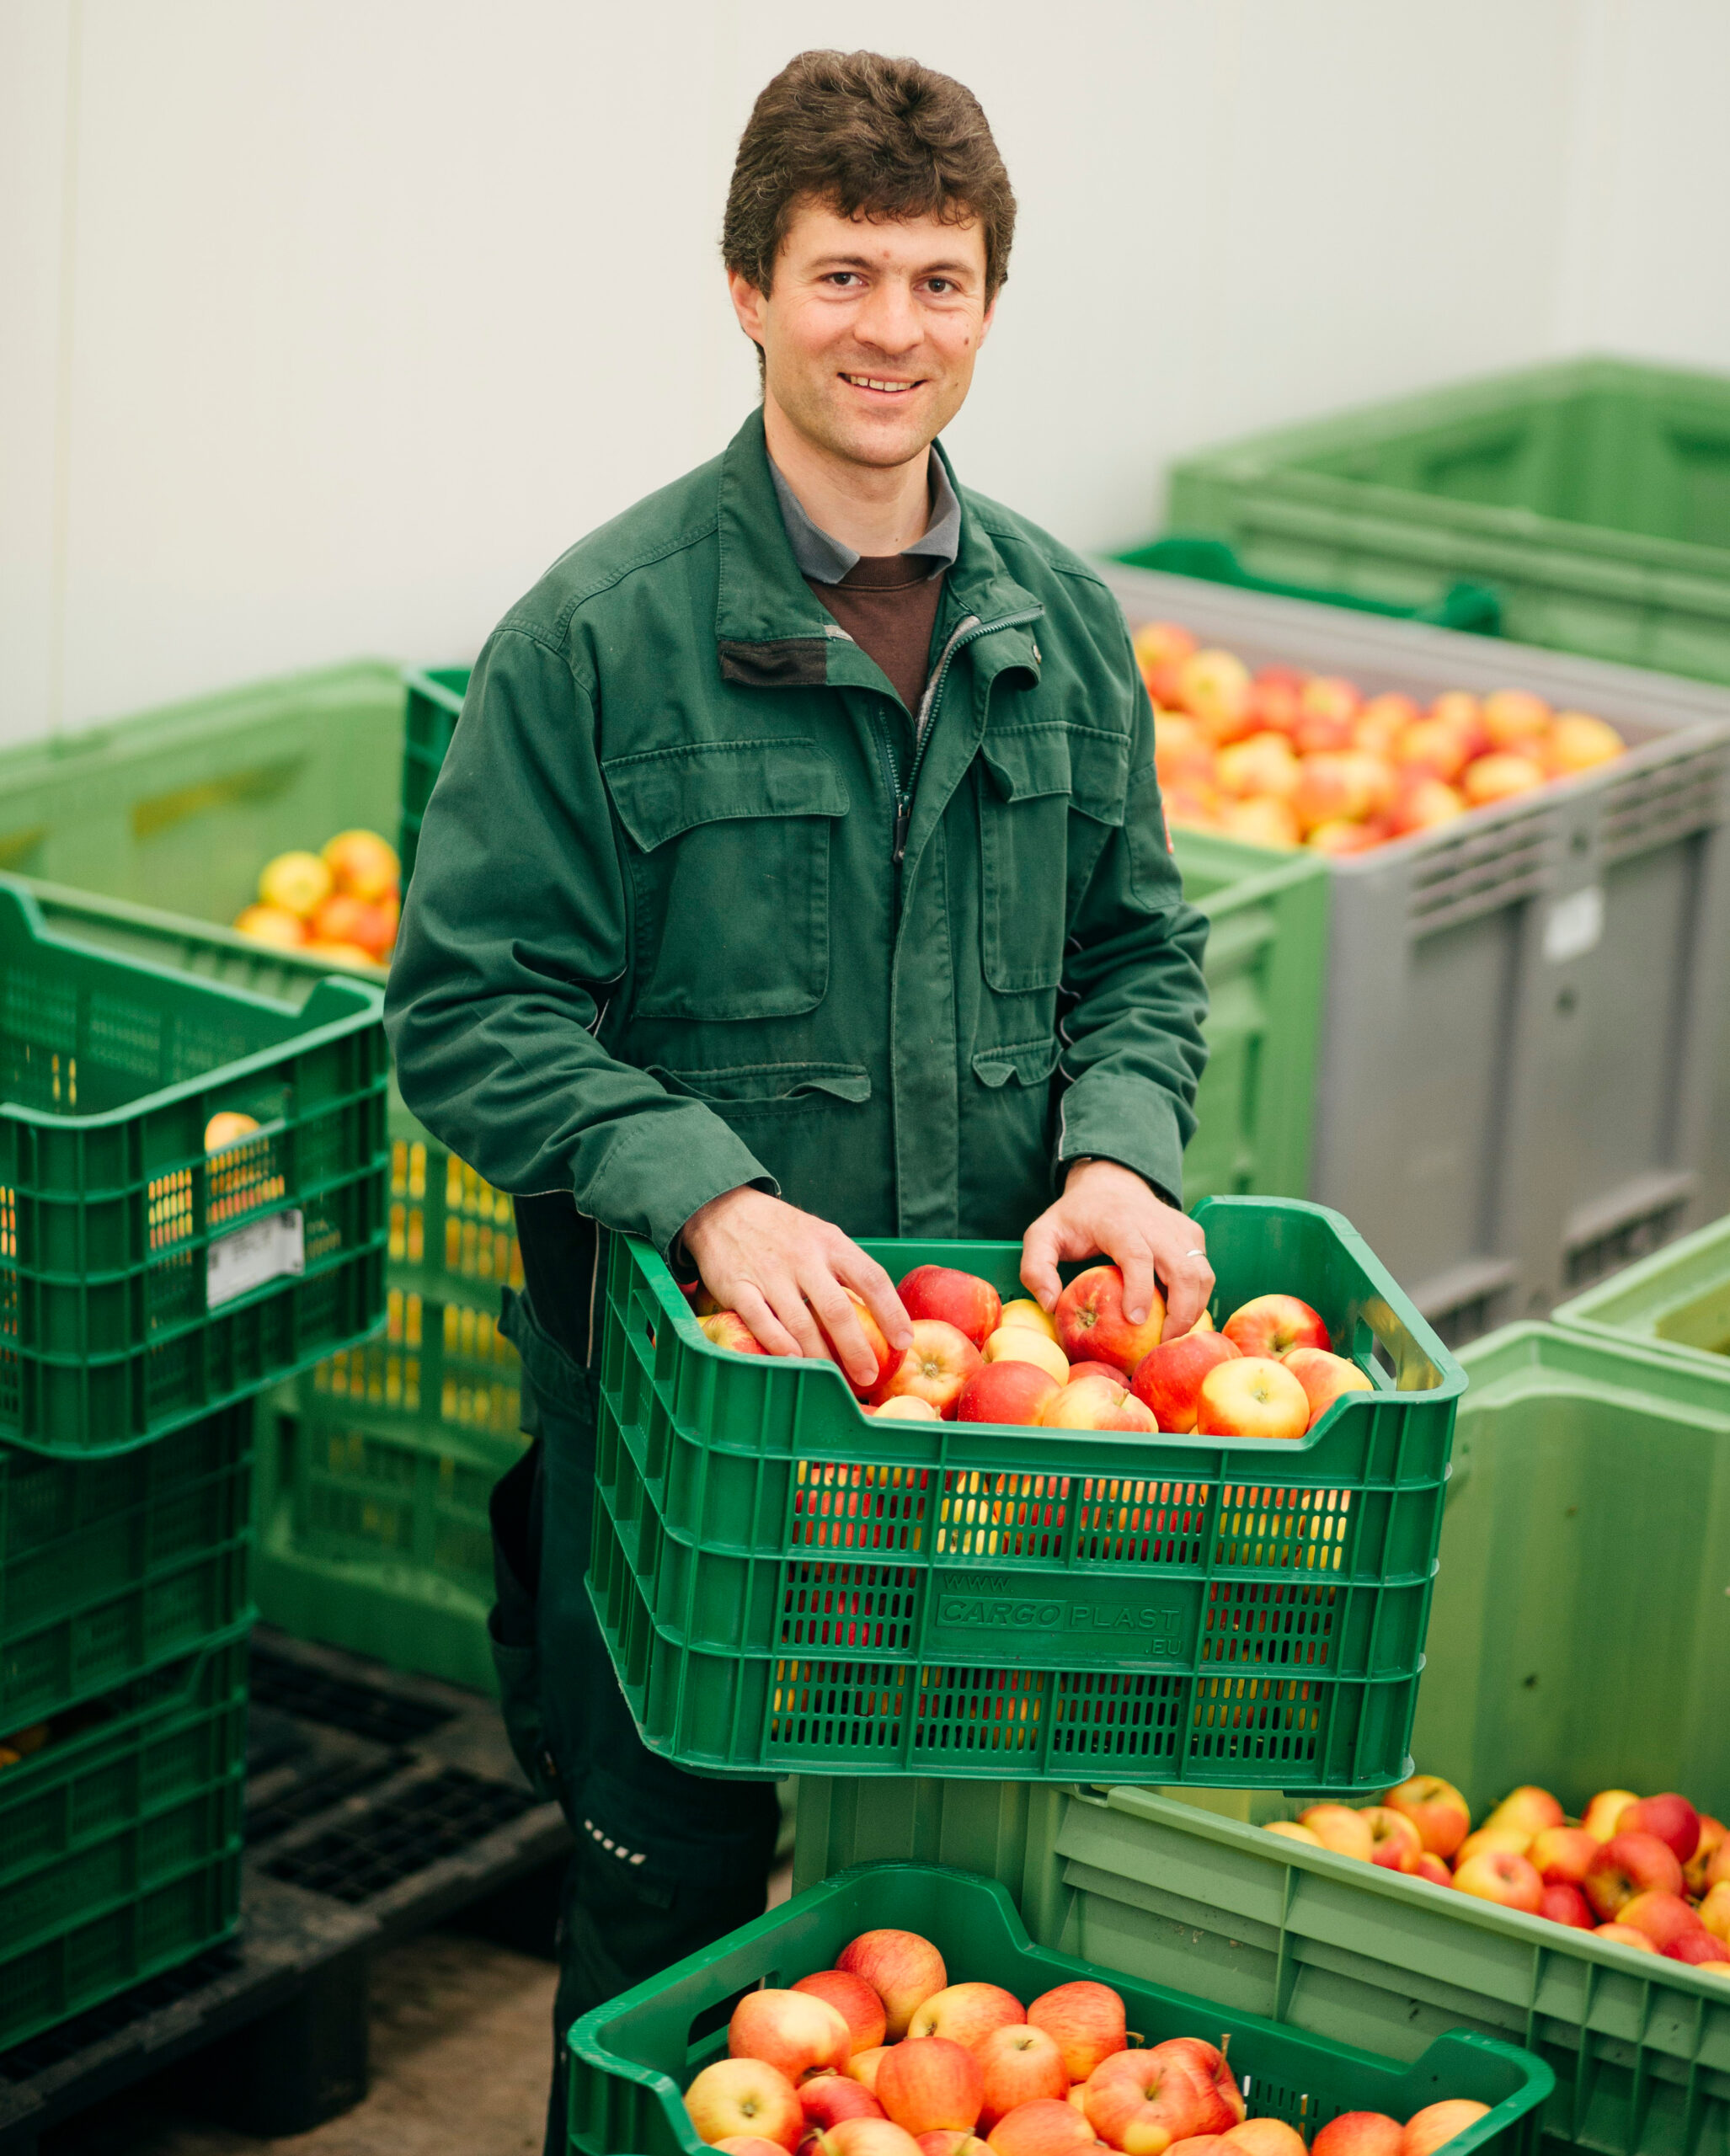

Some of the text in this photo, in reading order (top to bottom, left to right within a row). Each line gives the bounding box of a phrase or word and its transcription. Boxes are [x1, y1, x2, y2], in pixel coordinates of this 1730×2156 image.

[941, 1600, 1181, 1630] CARGO PLAST
[1145, 1638, 1182, 1656] .EU
